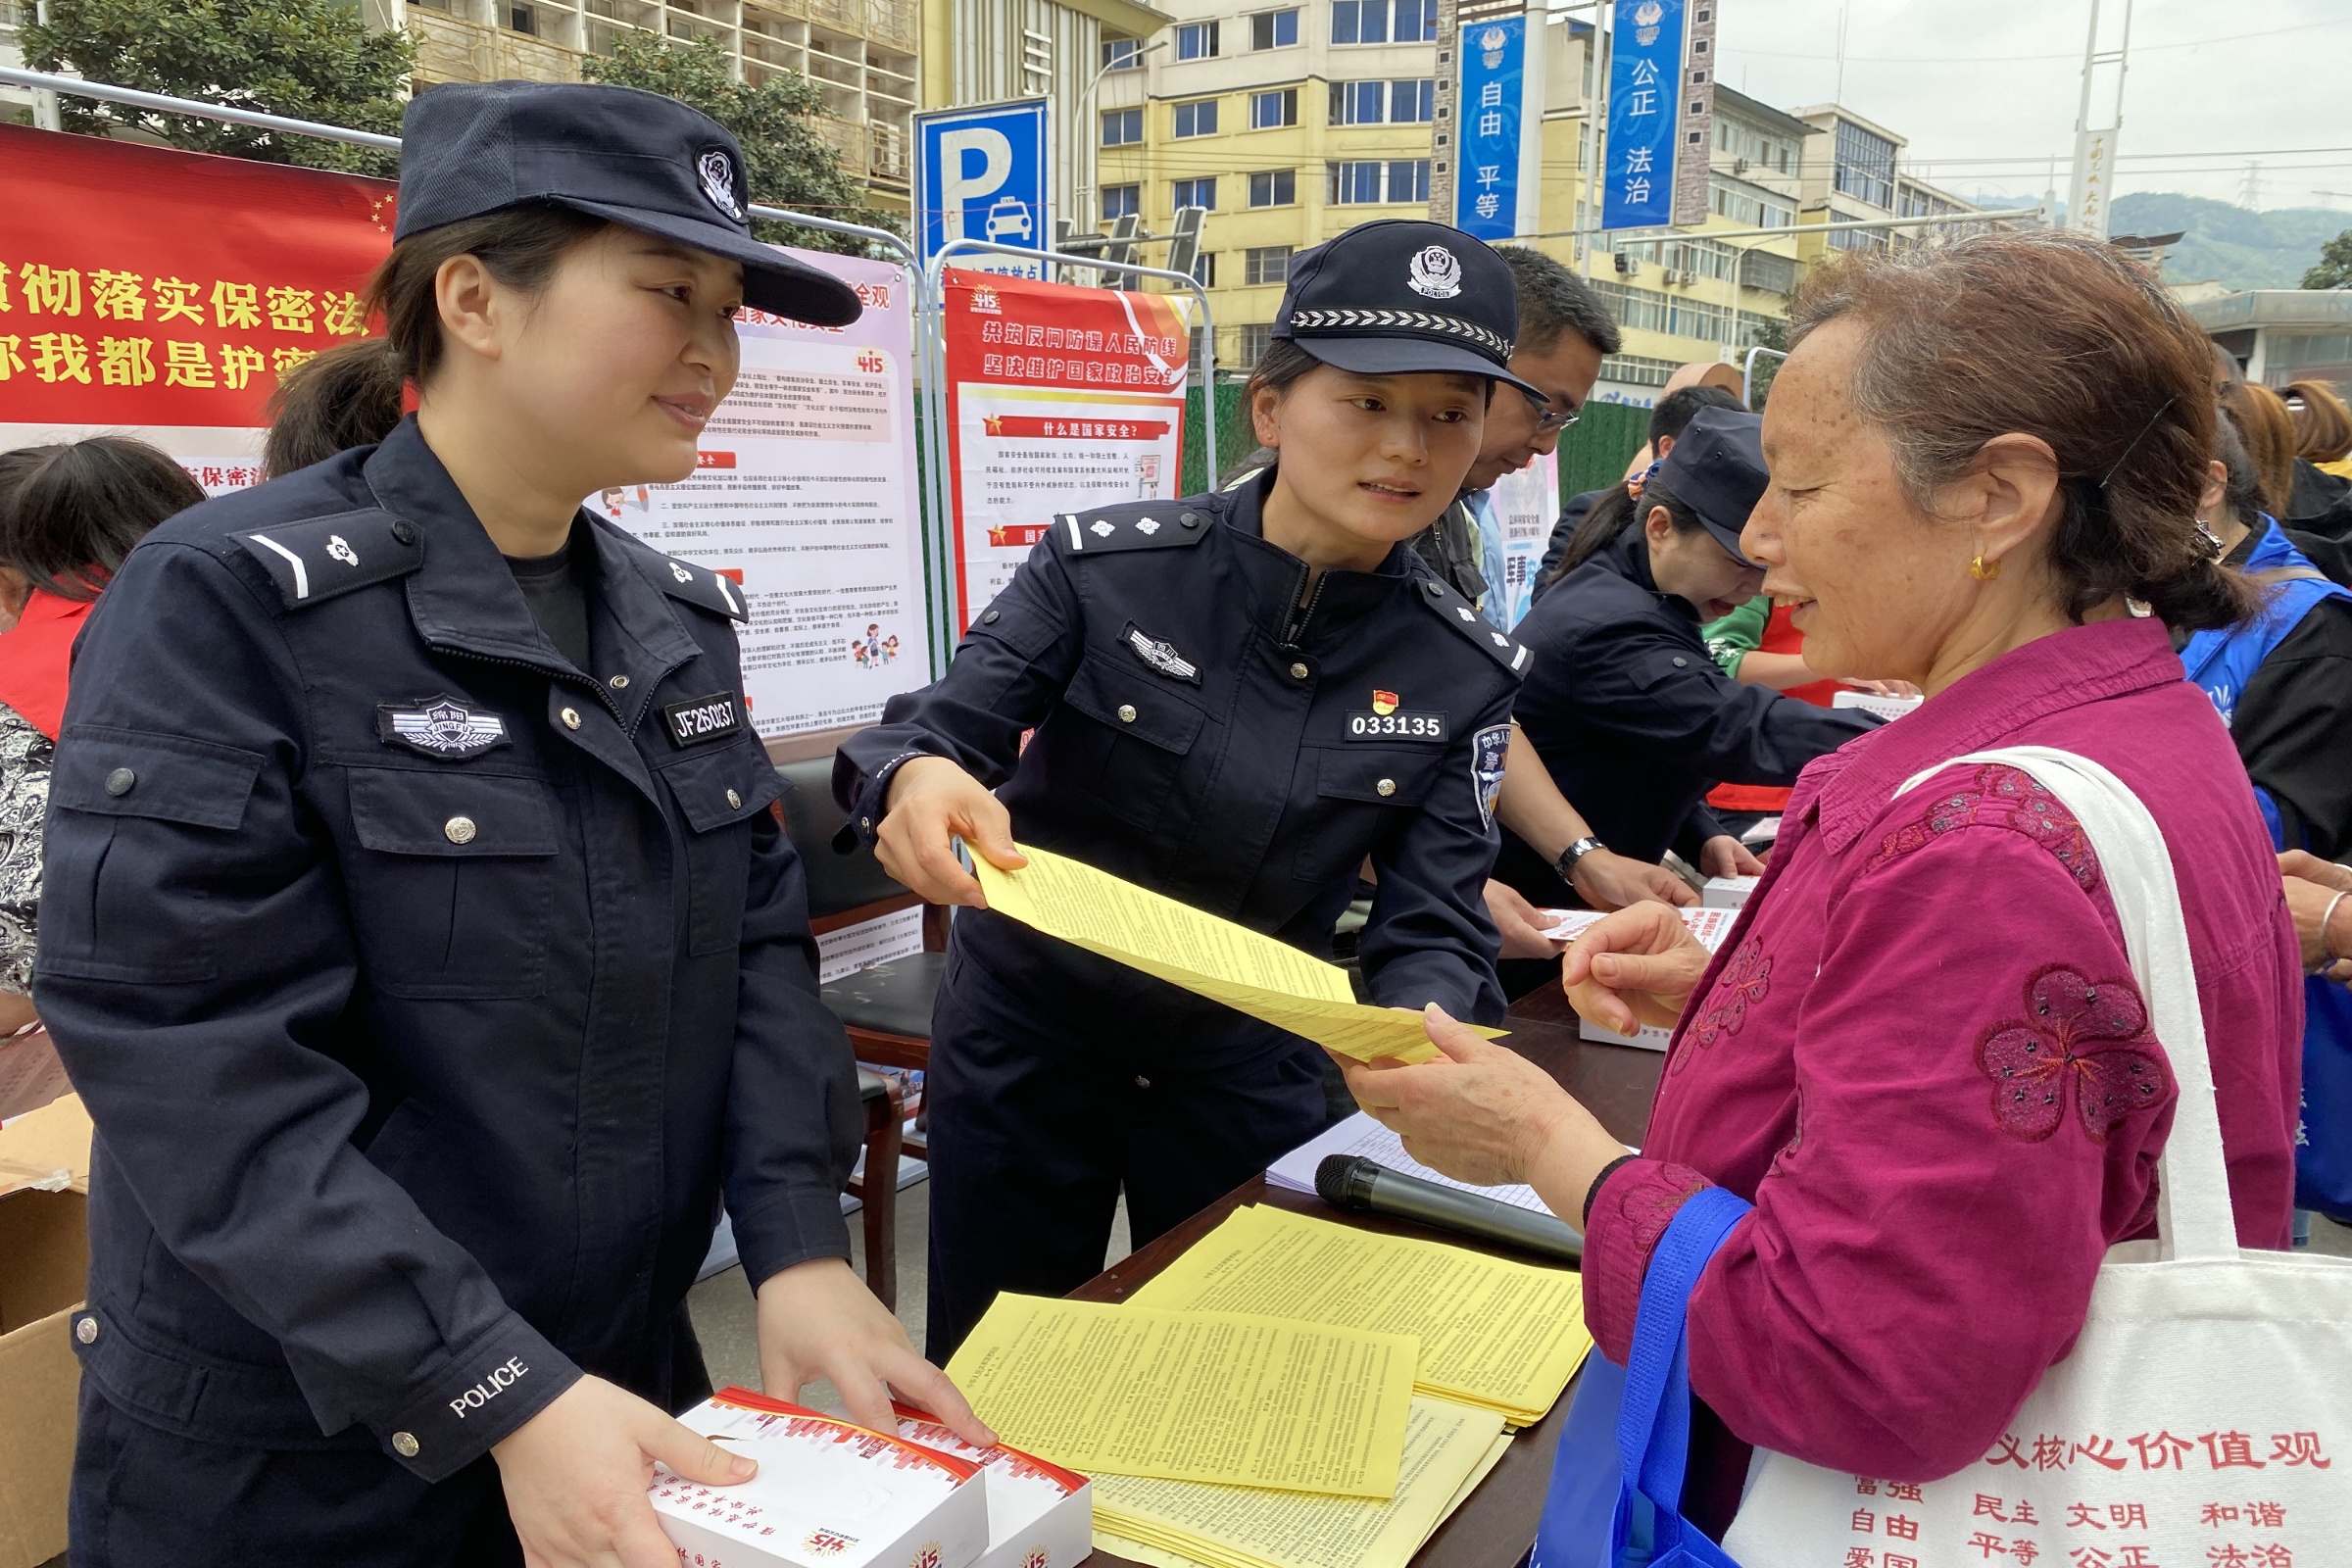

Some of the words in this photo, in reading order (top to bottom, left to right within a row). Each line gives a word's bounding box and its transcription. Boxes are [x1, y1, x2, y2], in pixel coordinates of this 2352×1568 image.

[1629, 58, 1659, 117] 公正
[1480, 81, 1502, 137] 自由
[941, 127, 1012, 243] P
[1475, 165, 1500, 220] 平等
[1624, 146, 1654, 205] 法治
[0, 262, 369, 337] 彻落实保密法
[848, 280, 890, 309] 全观
[983, 320, 1176, 357] 共筑反间防谍人民防线
[858, 355, 883, 373] 415
[983, 354, 1174, 386] 坚决维护国家政治安全
[1506, 555, 1543, 589] 军事安
[433, 722, 468, 732] JINGFU
[1352, 716, 1441, 736] 033135
[449, 1356, 529, 1419] POLICE
[1985, 1430, 2331, 1472] 义核心价值观
[1973, 1494, 2039, 1526] 民主
[2066, 1502, 2148, 1530] 文明
[2200, 1501, 2287, 1529] 和谐
[1843, 1546, 1918, 1568] 爱国
[1851, 1508, 1919, 1541] 自由
[1967, 1532, 2039, 1566] 平等
[2069, 1545, 2160, 1568] 公正
[2205, 1543, 2293, 1568] 法治
